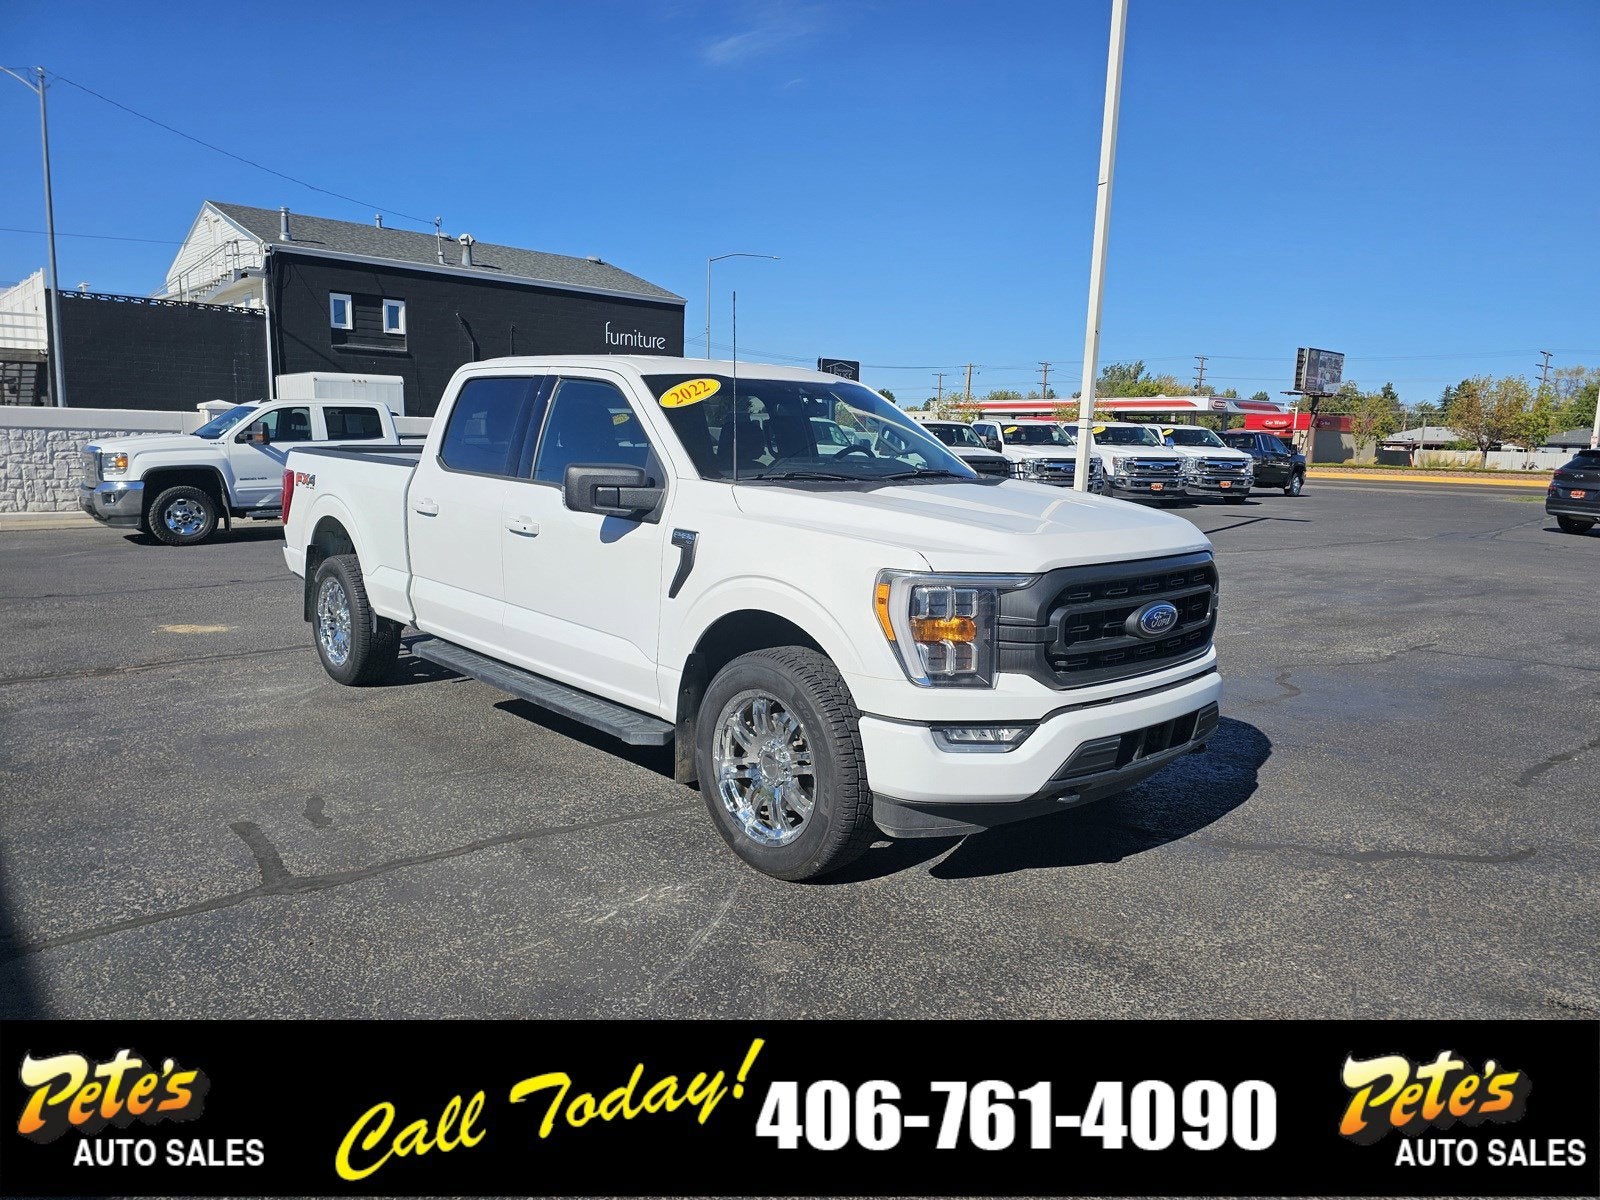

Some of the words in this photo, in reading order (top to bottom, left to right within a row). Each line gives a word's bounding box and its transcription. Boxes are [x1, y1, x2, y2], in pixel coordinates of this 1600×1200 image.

[605, 321, 666, 350] furniture
[670, 381, 710, 404] 2022
[296, 472, 316, 486] FX4
[1151, 611, 1171, 628] Ford
